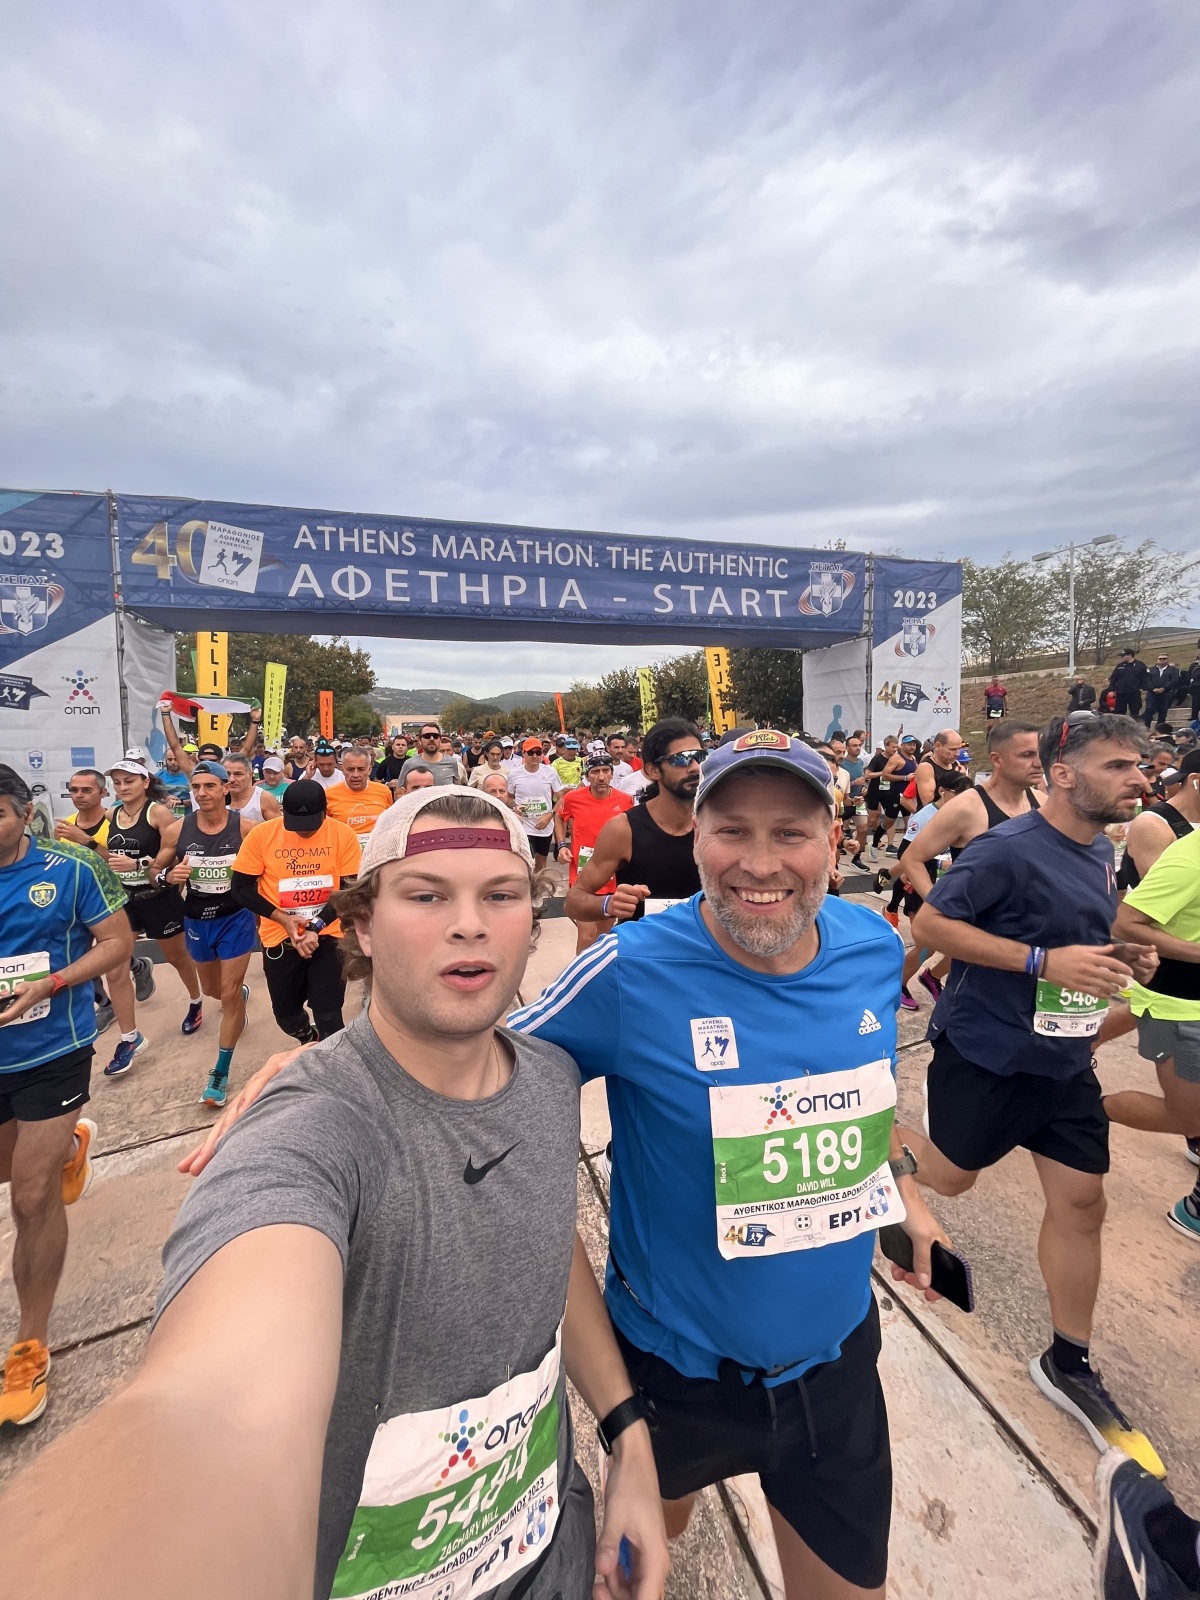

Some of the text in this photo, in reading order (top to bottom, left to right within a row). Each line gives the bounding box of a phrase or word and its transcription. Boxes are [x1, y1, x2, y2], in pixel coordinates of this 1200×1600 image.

[210, 525, 261, 542] ΜΑΡΑΘΩΝΙΟΣ
[218, 534, 251, 546] ΑΘΗΝΑΣ
[0, 530, 65, 559] 023
[294, 524, 789, 579] ATHENS MARATHON. THE AUTHENTIC
[287, 563, 588, 610] ΑΦΕΤΗΡΙΑ
[653, 583, 788, 618] START
[893, 590, 937, 609] 2023
[210, 632, 220, 731] ELIE
[932, 707, 952, 715] opap
[274, 847, 332, 859] COCO-MAT
[198, 867, 228, 879] 6006
[292, 889, 323, 903] 4327
[858, 1022, 882, 1035] adidas
[762, 1125, 863, 1184] 5189
[796, 1176, 837, 1194] DAVID WILL
[733, 1202, 786, 1216] ΑΥΘΕΝΤΙΚΟΣ
[786, 1192, 841, 1209] ΜΑΡΑΘΩΝΙΟΣ
[841, 1182, 869, 1199] ΔΡΟΜΟΣ
[410, 1427, 532, 1551] 5484
[438, 1505, 499, 1562] ZACHARY WILL
